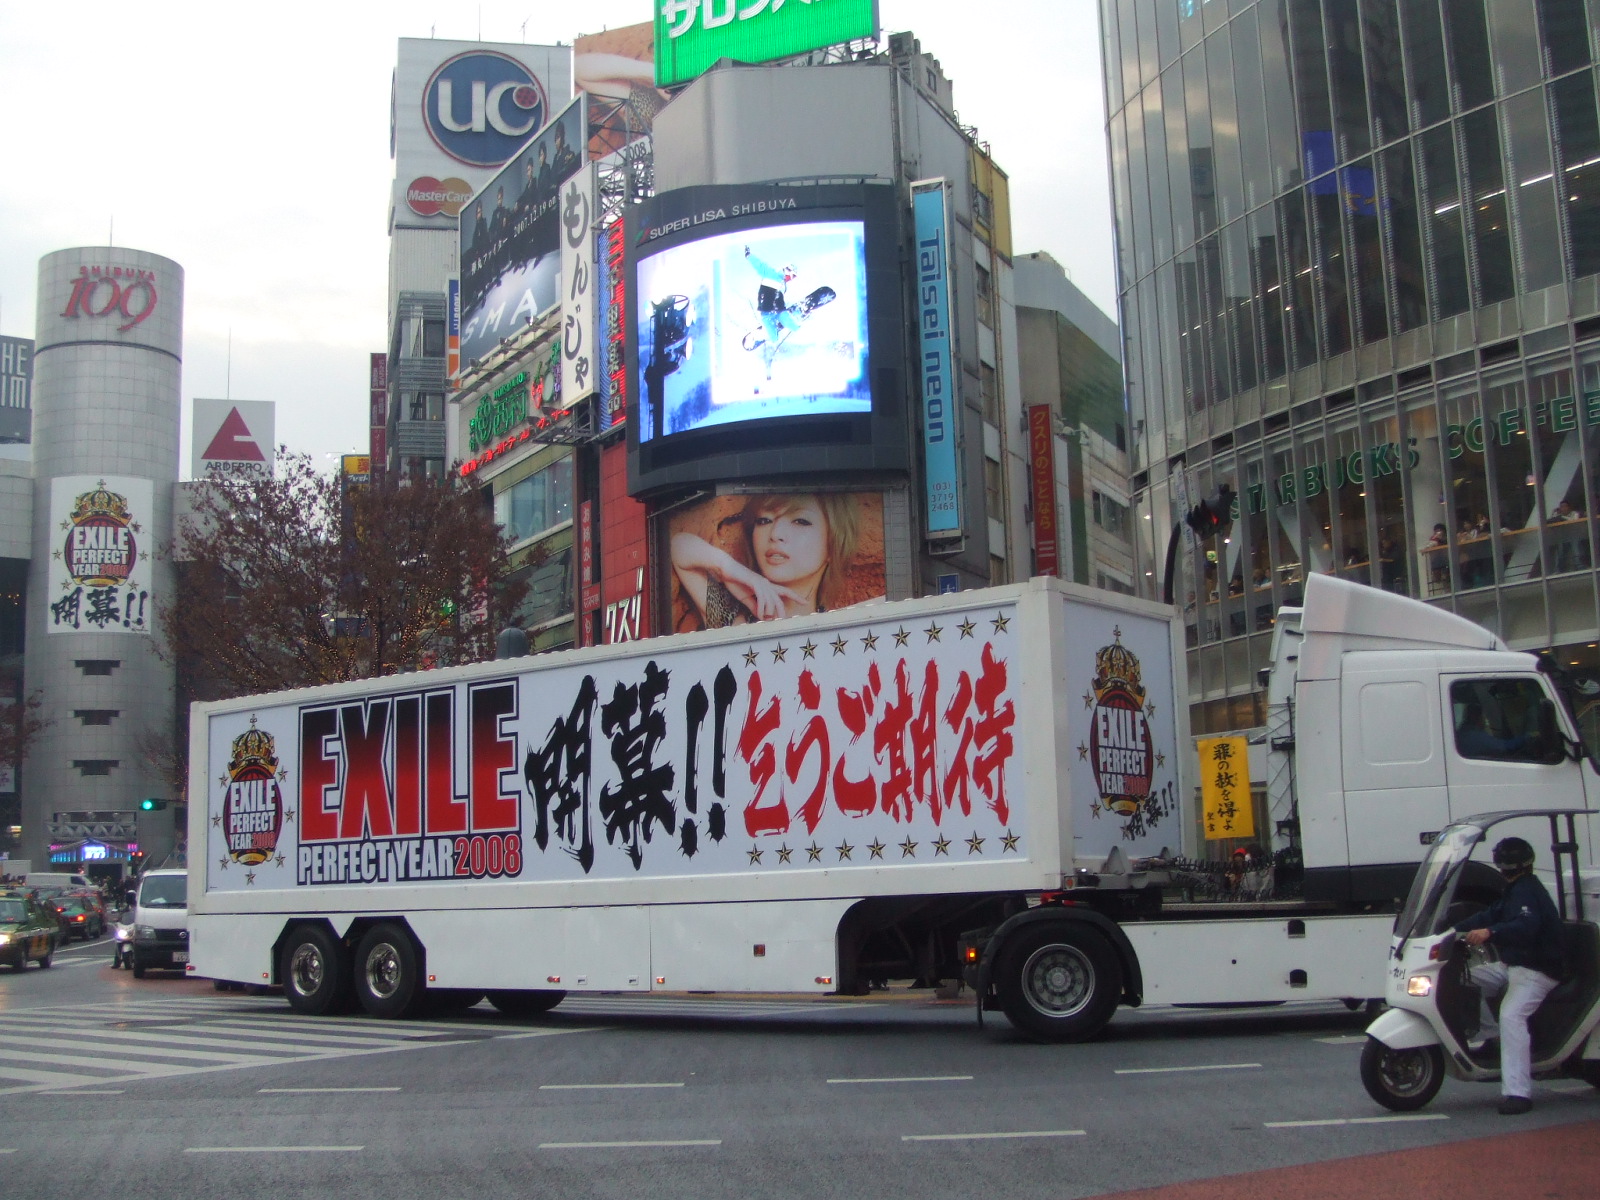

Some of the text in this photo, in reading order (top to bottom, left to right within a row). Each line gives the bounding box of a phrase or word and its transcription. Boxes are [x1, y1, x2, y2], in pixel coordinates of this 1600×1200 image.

[650, 198, 797, 239] SUPER LISA SHIBUYA
[80, 265, 156, 282] SHIBUYA
[563, 181, 590, 390] もんじゃ
[59, 276, 158, 332] 109
[919, 228, 946, 445] Taisei neon
[1447, 389, 1600, 460] COFFEE
[1033, 411, 1052, 529] クスリのことなら
[931, 492, 954, 502] 3719
[931, 502, 955, 512] 2468
[73, 526, 129, 550] EXILE
[72, 564, 100, 576] YEAR
[73, 550, 129, 564] PERFECT
[605, 594, 642, 645] クスリ
[1096, 705, 1146, 751] EXILE
[298, 677, 521, 843] EXILE
[1099, 746, 1147, 776] PERFECT
[231, 779, 276, 813] EXILE
[1100, 773, 1124, 795] YEAR
[230, 811, 276, 834] PERFECT
[230, 831, 276, 850] YEAR 2008
[299, 834, 522, 885] PERFECT YEAR 2008
